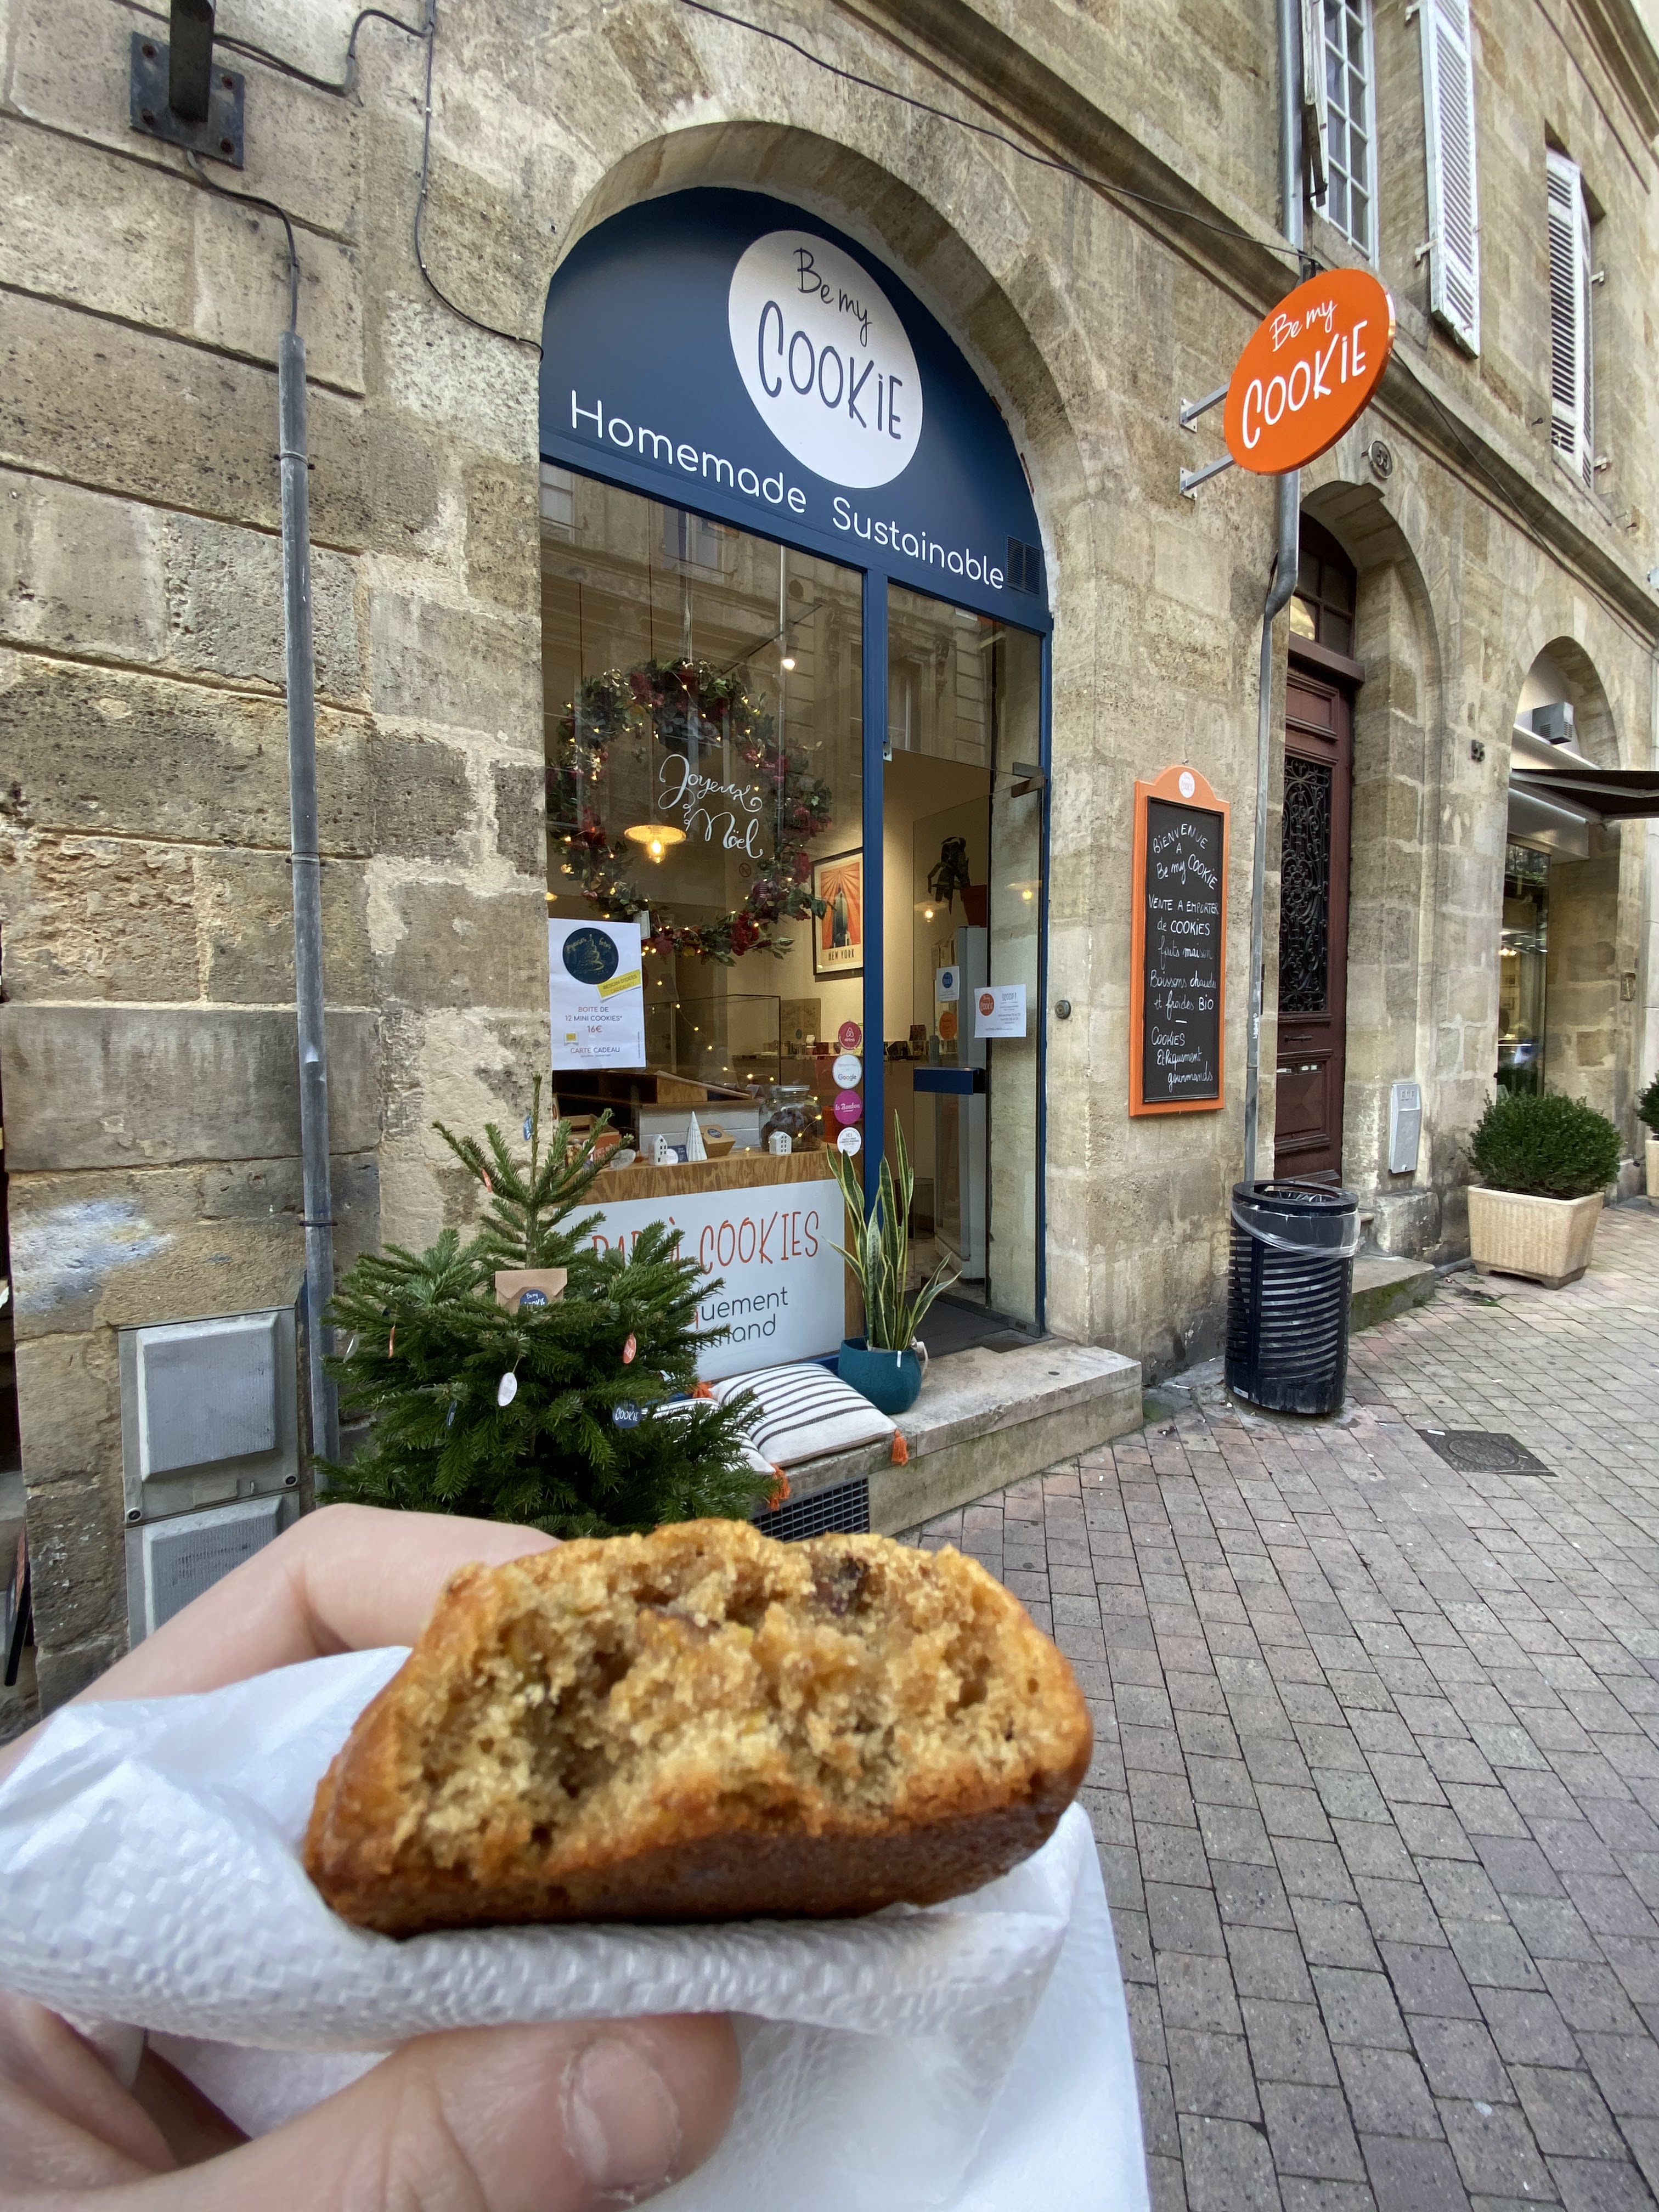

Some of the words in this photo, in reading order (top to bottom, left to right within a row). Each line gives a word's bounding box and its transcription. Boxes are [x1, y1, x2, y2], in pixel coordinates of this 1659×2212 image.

[794, 247, 833, 304] Be
[837, 294, 872, 346] my
[1269, 313, 1302, 352] Be
[1306, 300, 1338, 333] my
[571, 390, 807, 514] Homemade
[832, 496, 1004, 590] Sustainable
[658, 754, 763, 812] Joyeux
[684, 809, 763, 858] Noël
[1156, 862, 1169, 879] Be
[1171, 860, 1186, 885] my
[1148, 894, 1173, 911] VENTE
[1177, 900, 1183, 911] A
[1186, 900, 1220, 915] EMPORTER
[1157, 917, 1167, 932] de
[828, 951, 838, 961] NEW
[841, 949, 854, 960] YORK
[1158, 936, 1180, 970] faits
[1182, 943, 1213, 960] maison
[1150, 969, 1187, 988] Boissons
[1154, 998, 1162, 1010] et
[1165, 990, 1194, 1020] froides
[1167, 1060, 1213, 1093] gourmands
[699, 1211, 819, 1274] COOKIES
